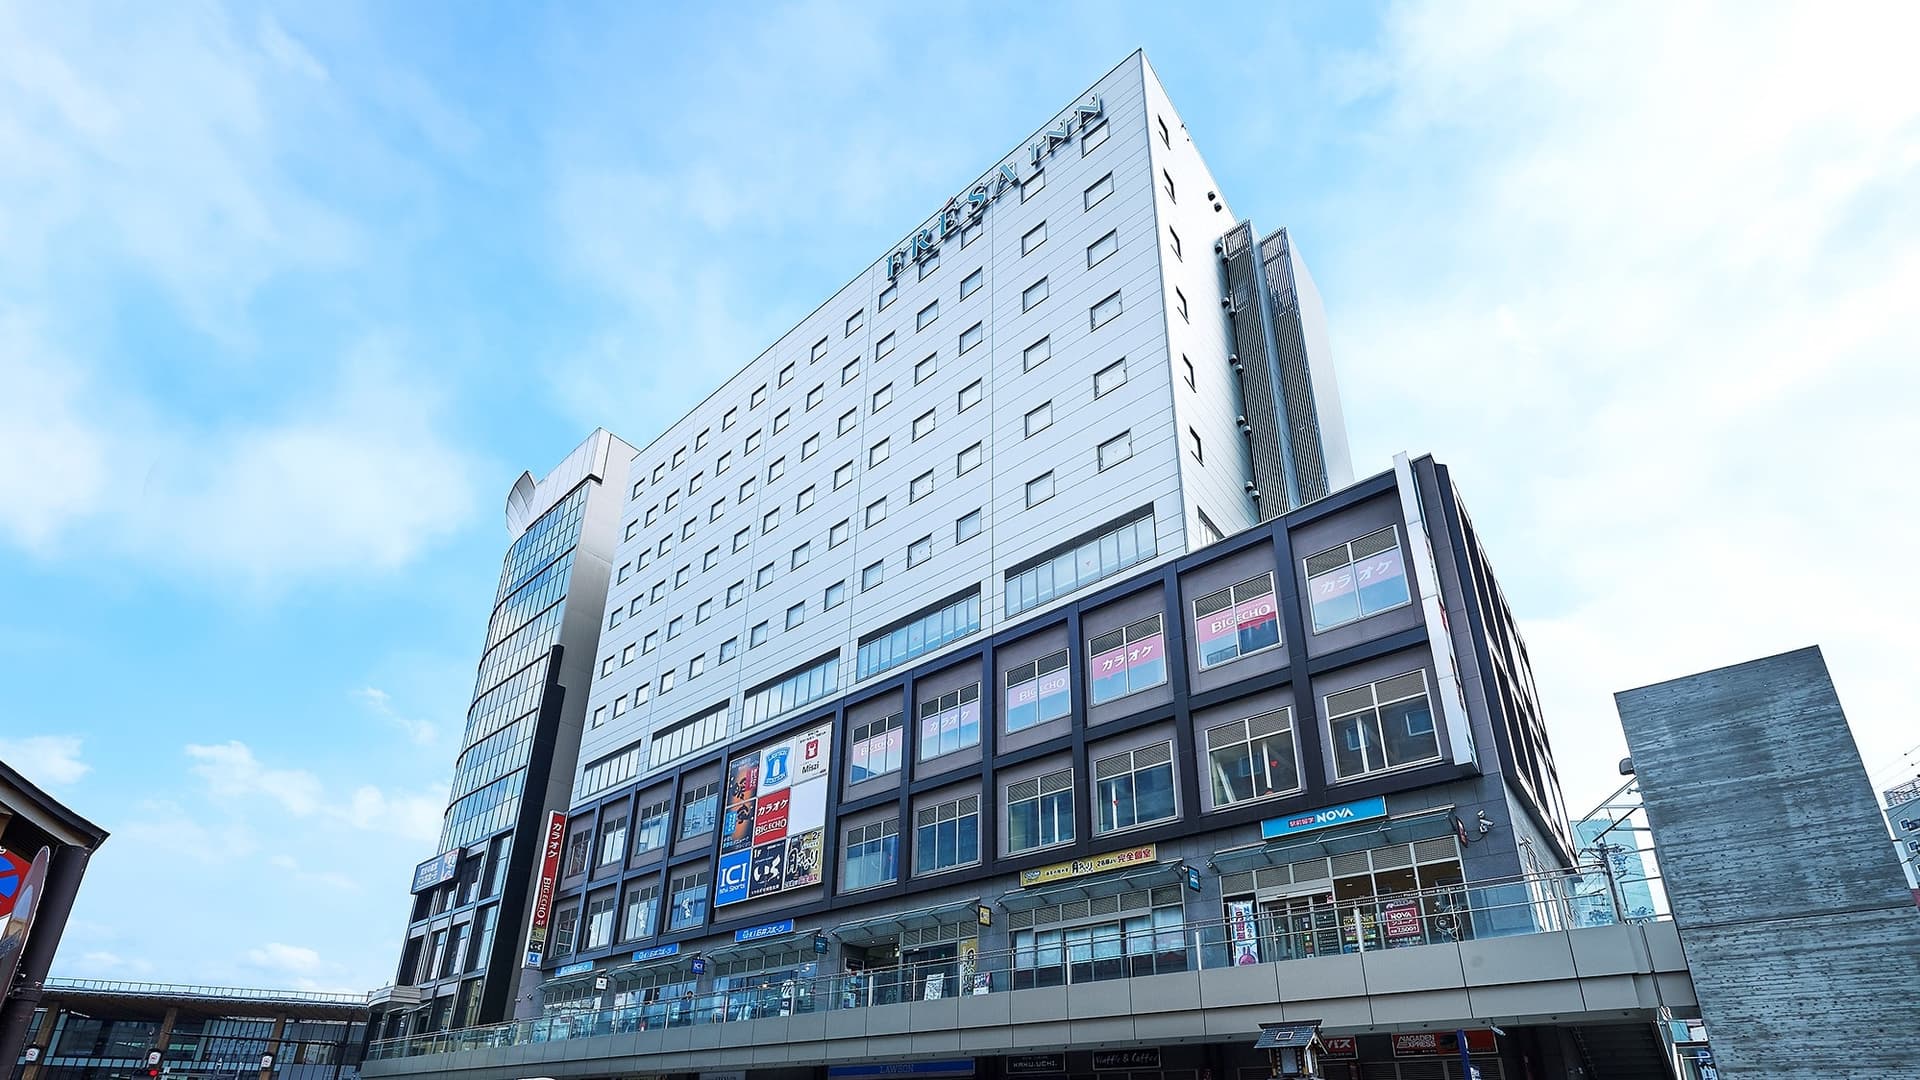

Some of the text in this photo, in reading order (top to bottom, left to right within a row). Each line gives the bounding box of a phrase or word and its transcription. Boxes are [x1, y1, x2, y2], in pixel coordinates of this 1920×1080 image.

[1028, 92, 1103, 166] INN
[1320, 558, 1393, 594] カラオケ
[1211, 604, 1272, 634] BIG ECHO
[1101, 644, 1155, 673] カラオケ
[1019, 677, 1065, 702] BIG ECHO
[930, 710, 971, 733] カラオケ
[757, 799, 789, 817] カラオケ
[1316, 807, 1354, 823] NOVA
[755, 818, 787, 836] BIG ECHO
[547, 822, 562, 858] カラオケ
[720, 862, 748, 888] ICI
[537, 877, 552, 919] BIG ECHO
[1390, 912, 1412, 921] NOVA
[1400, 1034, 1435, 1042] NAGADEN
[880, 1063, 914, 1074] LAWSON
